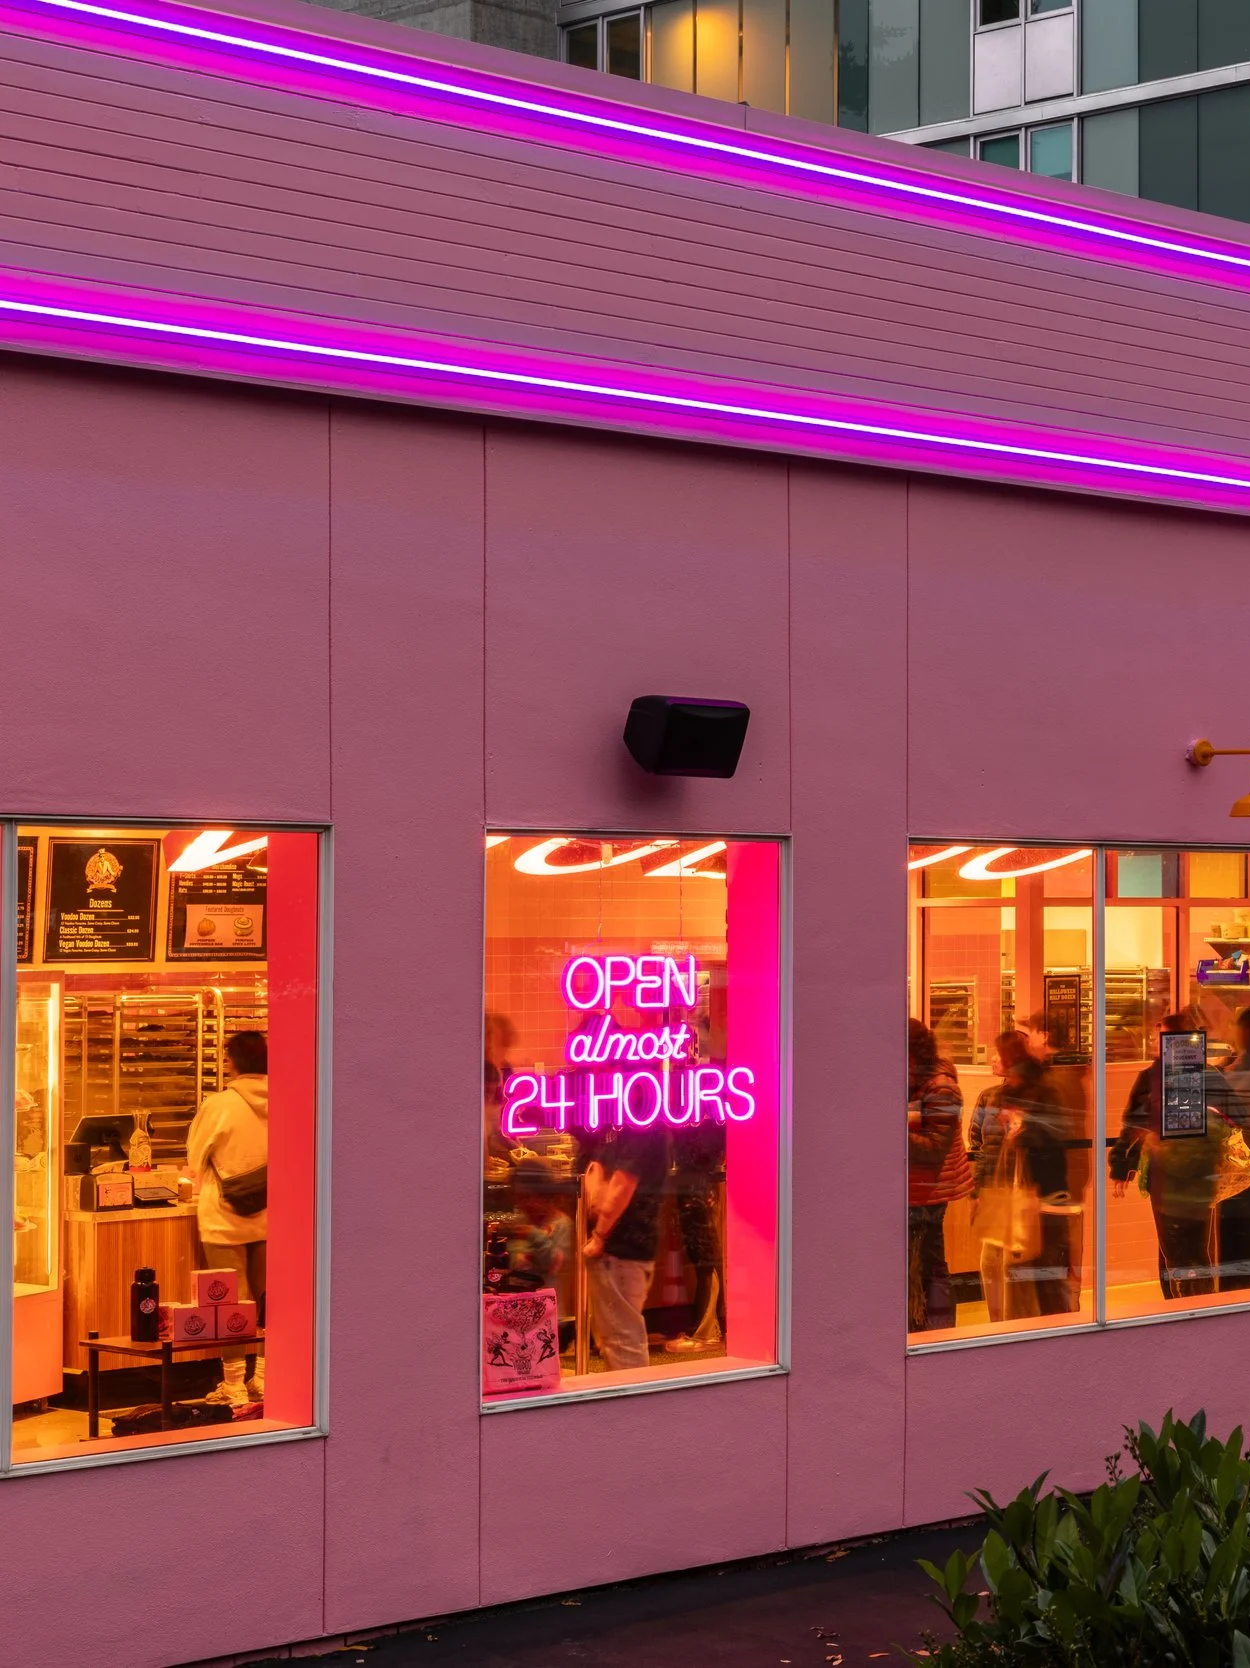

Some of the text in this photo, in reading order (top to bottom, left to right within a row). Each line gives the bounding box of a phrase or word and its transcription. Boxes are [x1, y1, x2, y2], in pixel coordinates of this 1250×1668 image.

[89, 898, 113, 908] Dozens
[61, 912, 95, 920] Voodoo Dozen
[59, 926, 78, 934] Classic
[78, 926, 94, 934] Dozen
[59, 940, 110, 949] Vegan Voodoo Dozen
[565, 954, 697, 1010] OPEN
[568, 1014, 691, 1063] almost
[506, 1066, 756, 1134] 24 HOURS
